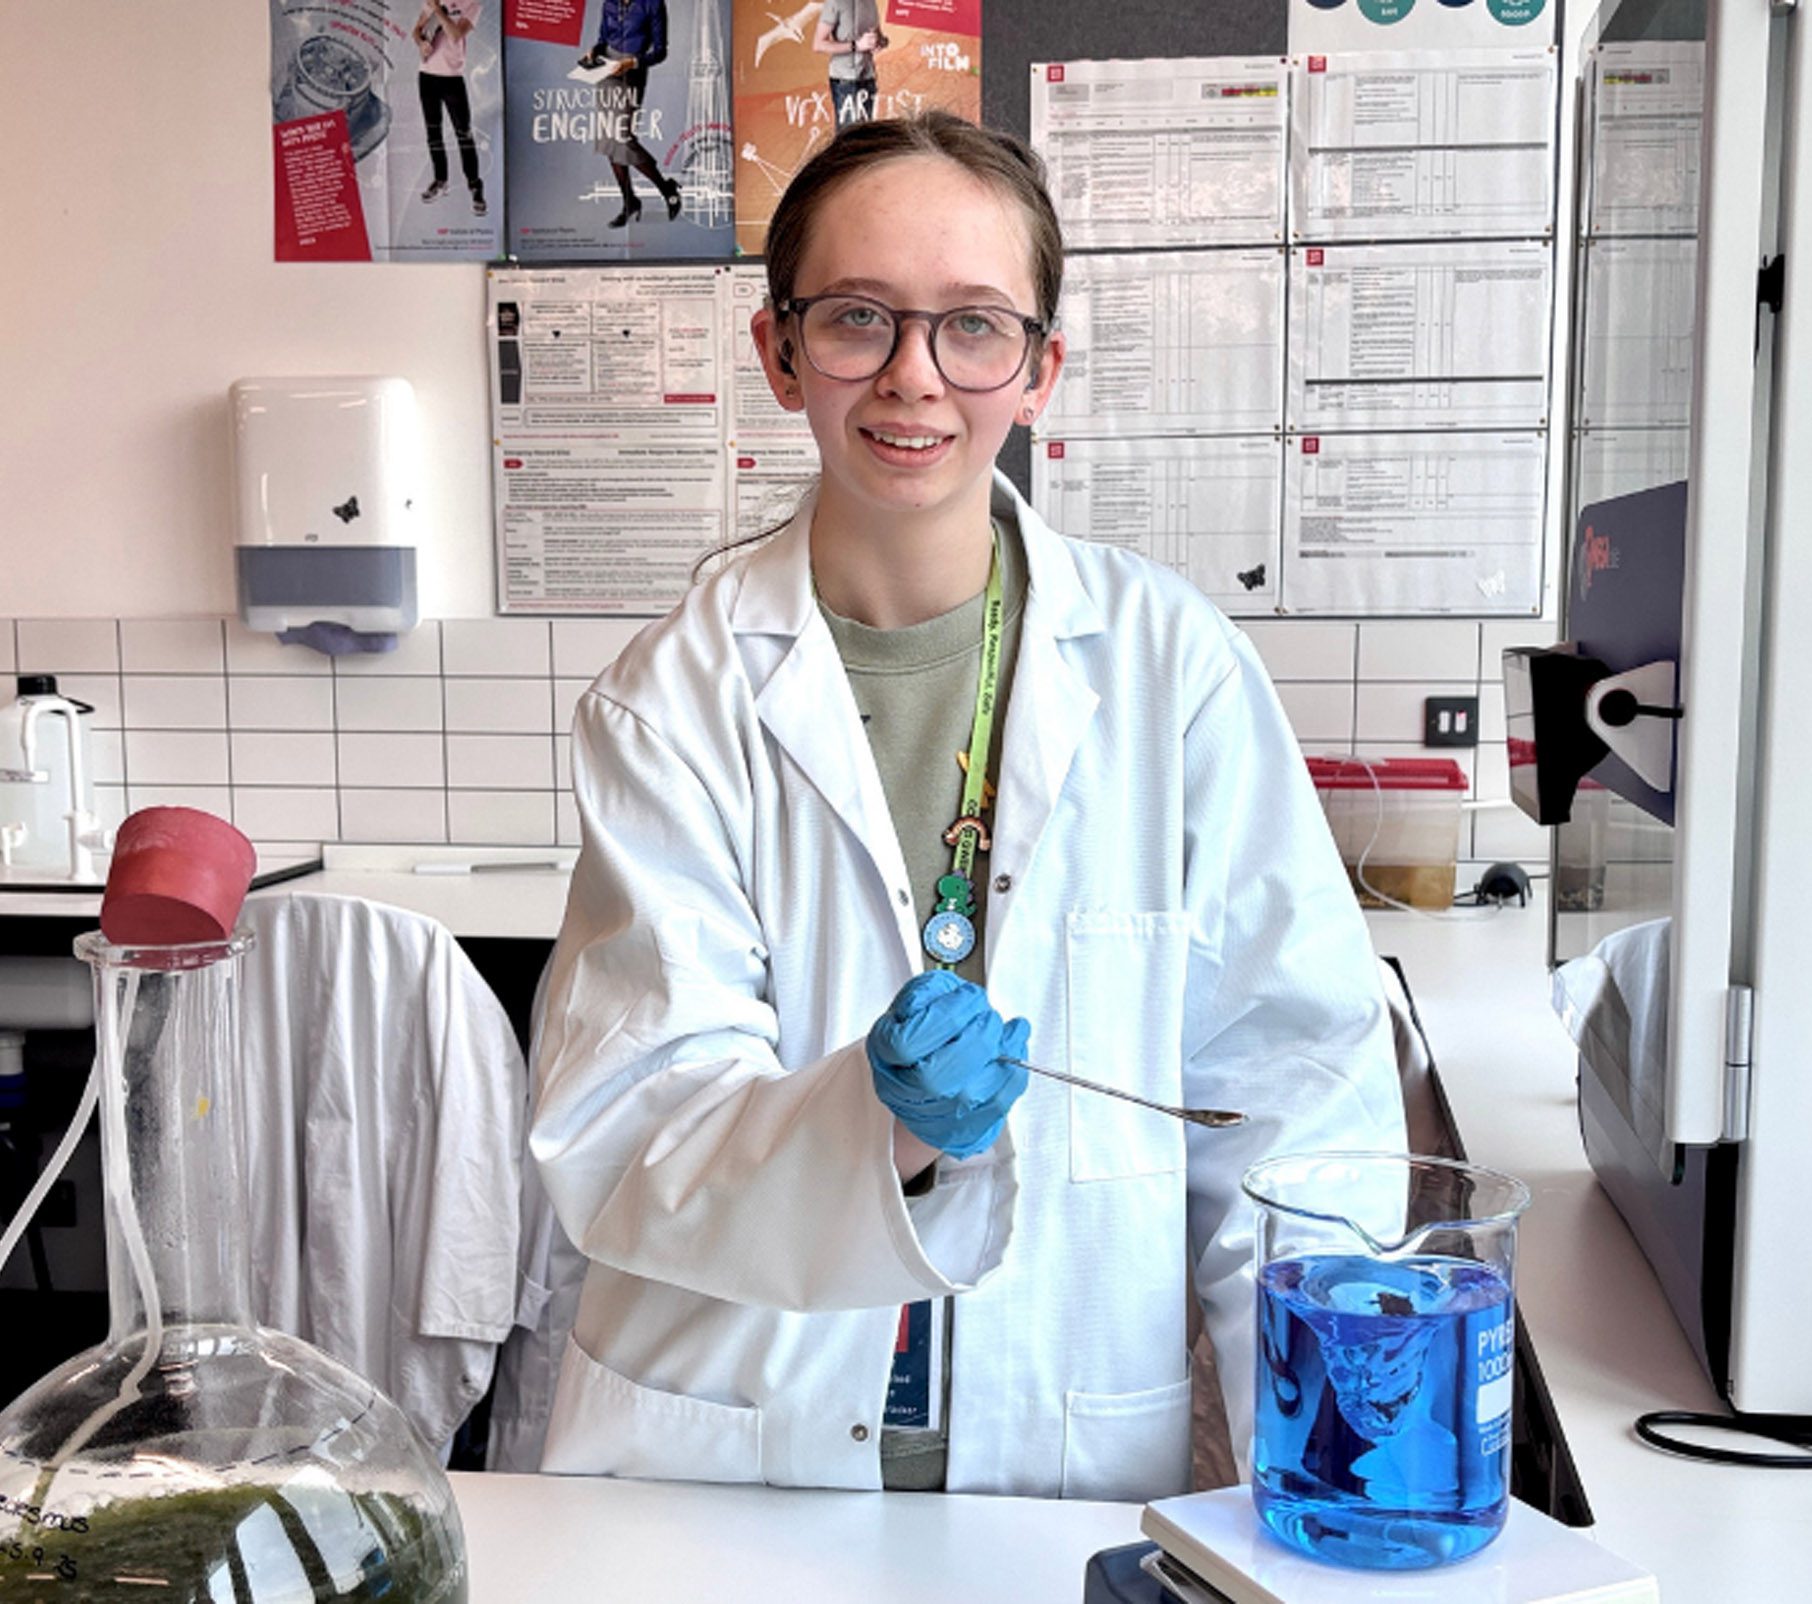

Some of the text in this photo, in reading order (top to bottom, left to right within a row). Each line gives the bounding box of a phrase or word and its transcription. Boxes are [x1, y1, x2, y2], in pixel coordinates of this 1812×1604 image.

[920, 42, 960, 57] INTO
[928, 55, 970, 72] FILM
[533, 85, 640, 111] STRUCTURAL
[785, 89, 928, 128] VFX ARTIST
[532, 108, 663, 144] ENGINEER
